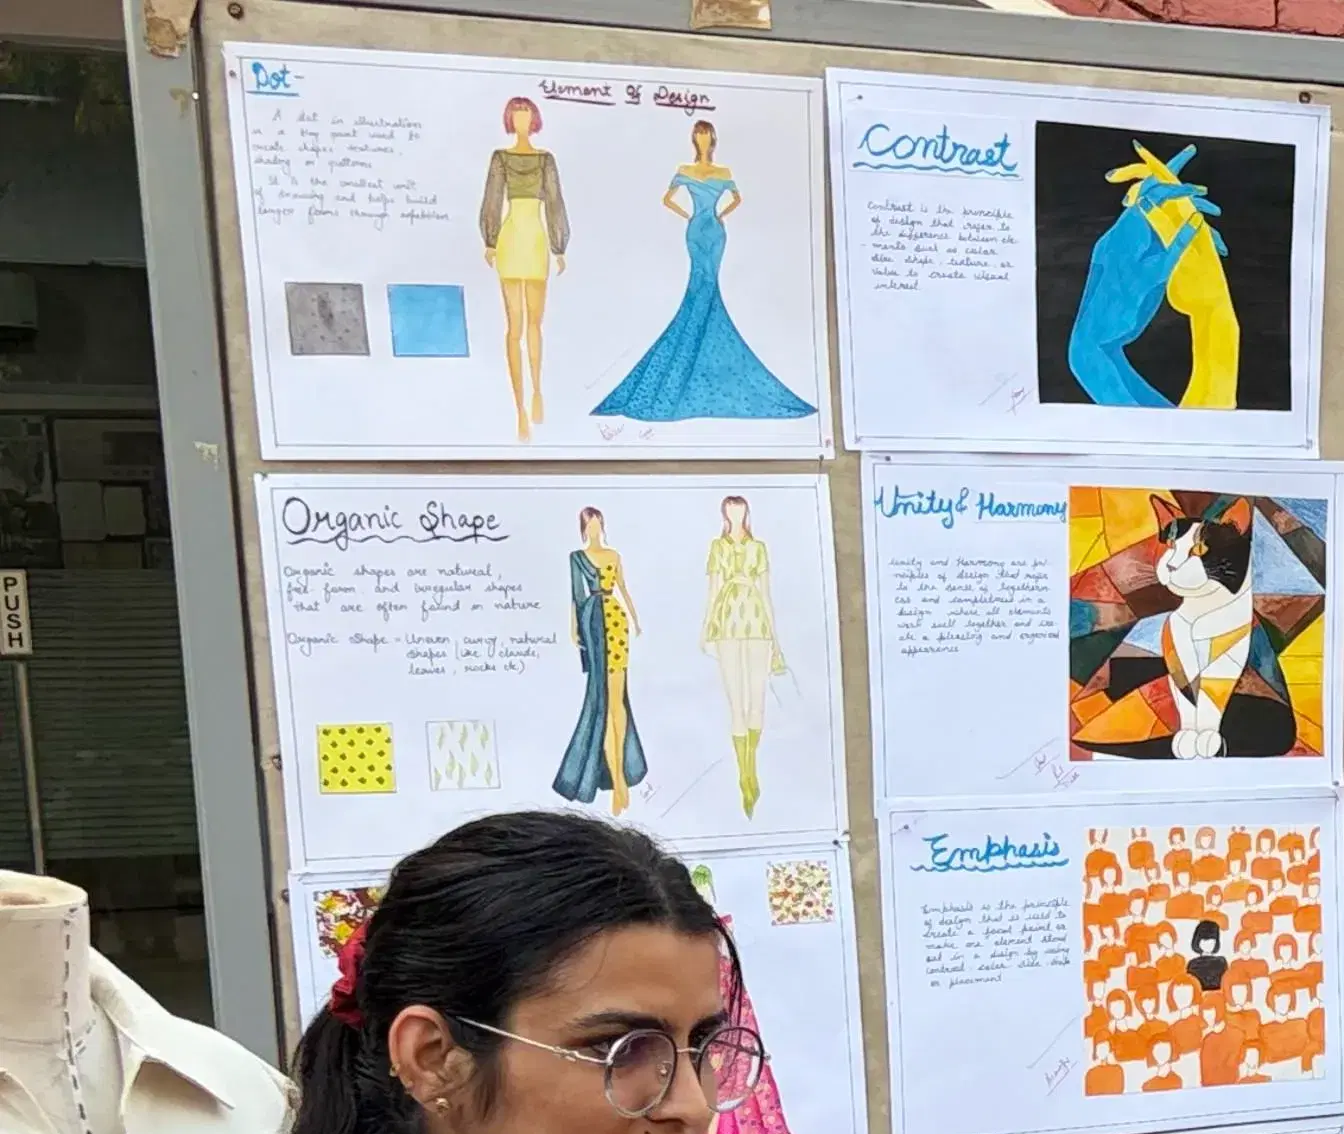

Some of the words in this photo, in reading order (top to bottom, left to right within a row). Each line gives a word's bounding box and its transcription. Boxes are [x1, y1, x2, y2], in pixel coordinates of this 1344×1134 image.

[653, 86, 710, 116] Design
[858, 124, 1018, 171] Contrast
[976, 492, 1068, 523] Harmony
[282, 496, 402, 551] Organic
[419, 500, 499, 543] Shape
[284, 563, 335, 585] Organic
[354, 564, 395, 587] shapes
[407, 568, 426, 577] are
[375, 584, 399, 593] and
[3, 576, 23, 648] PUSH
[293, 602, 320, 612] that
[377, 602, 407, 622] often
[421, 601, 460, 622] found
[494, 600, 541, 610] nature
[922, 832, 1060, 866] Emphasis
